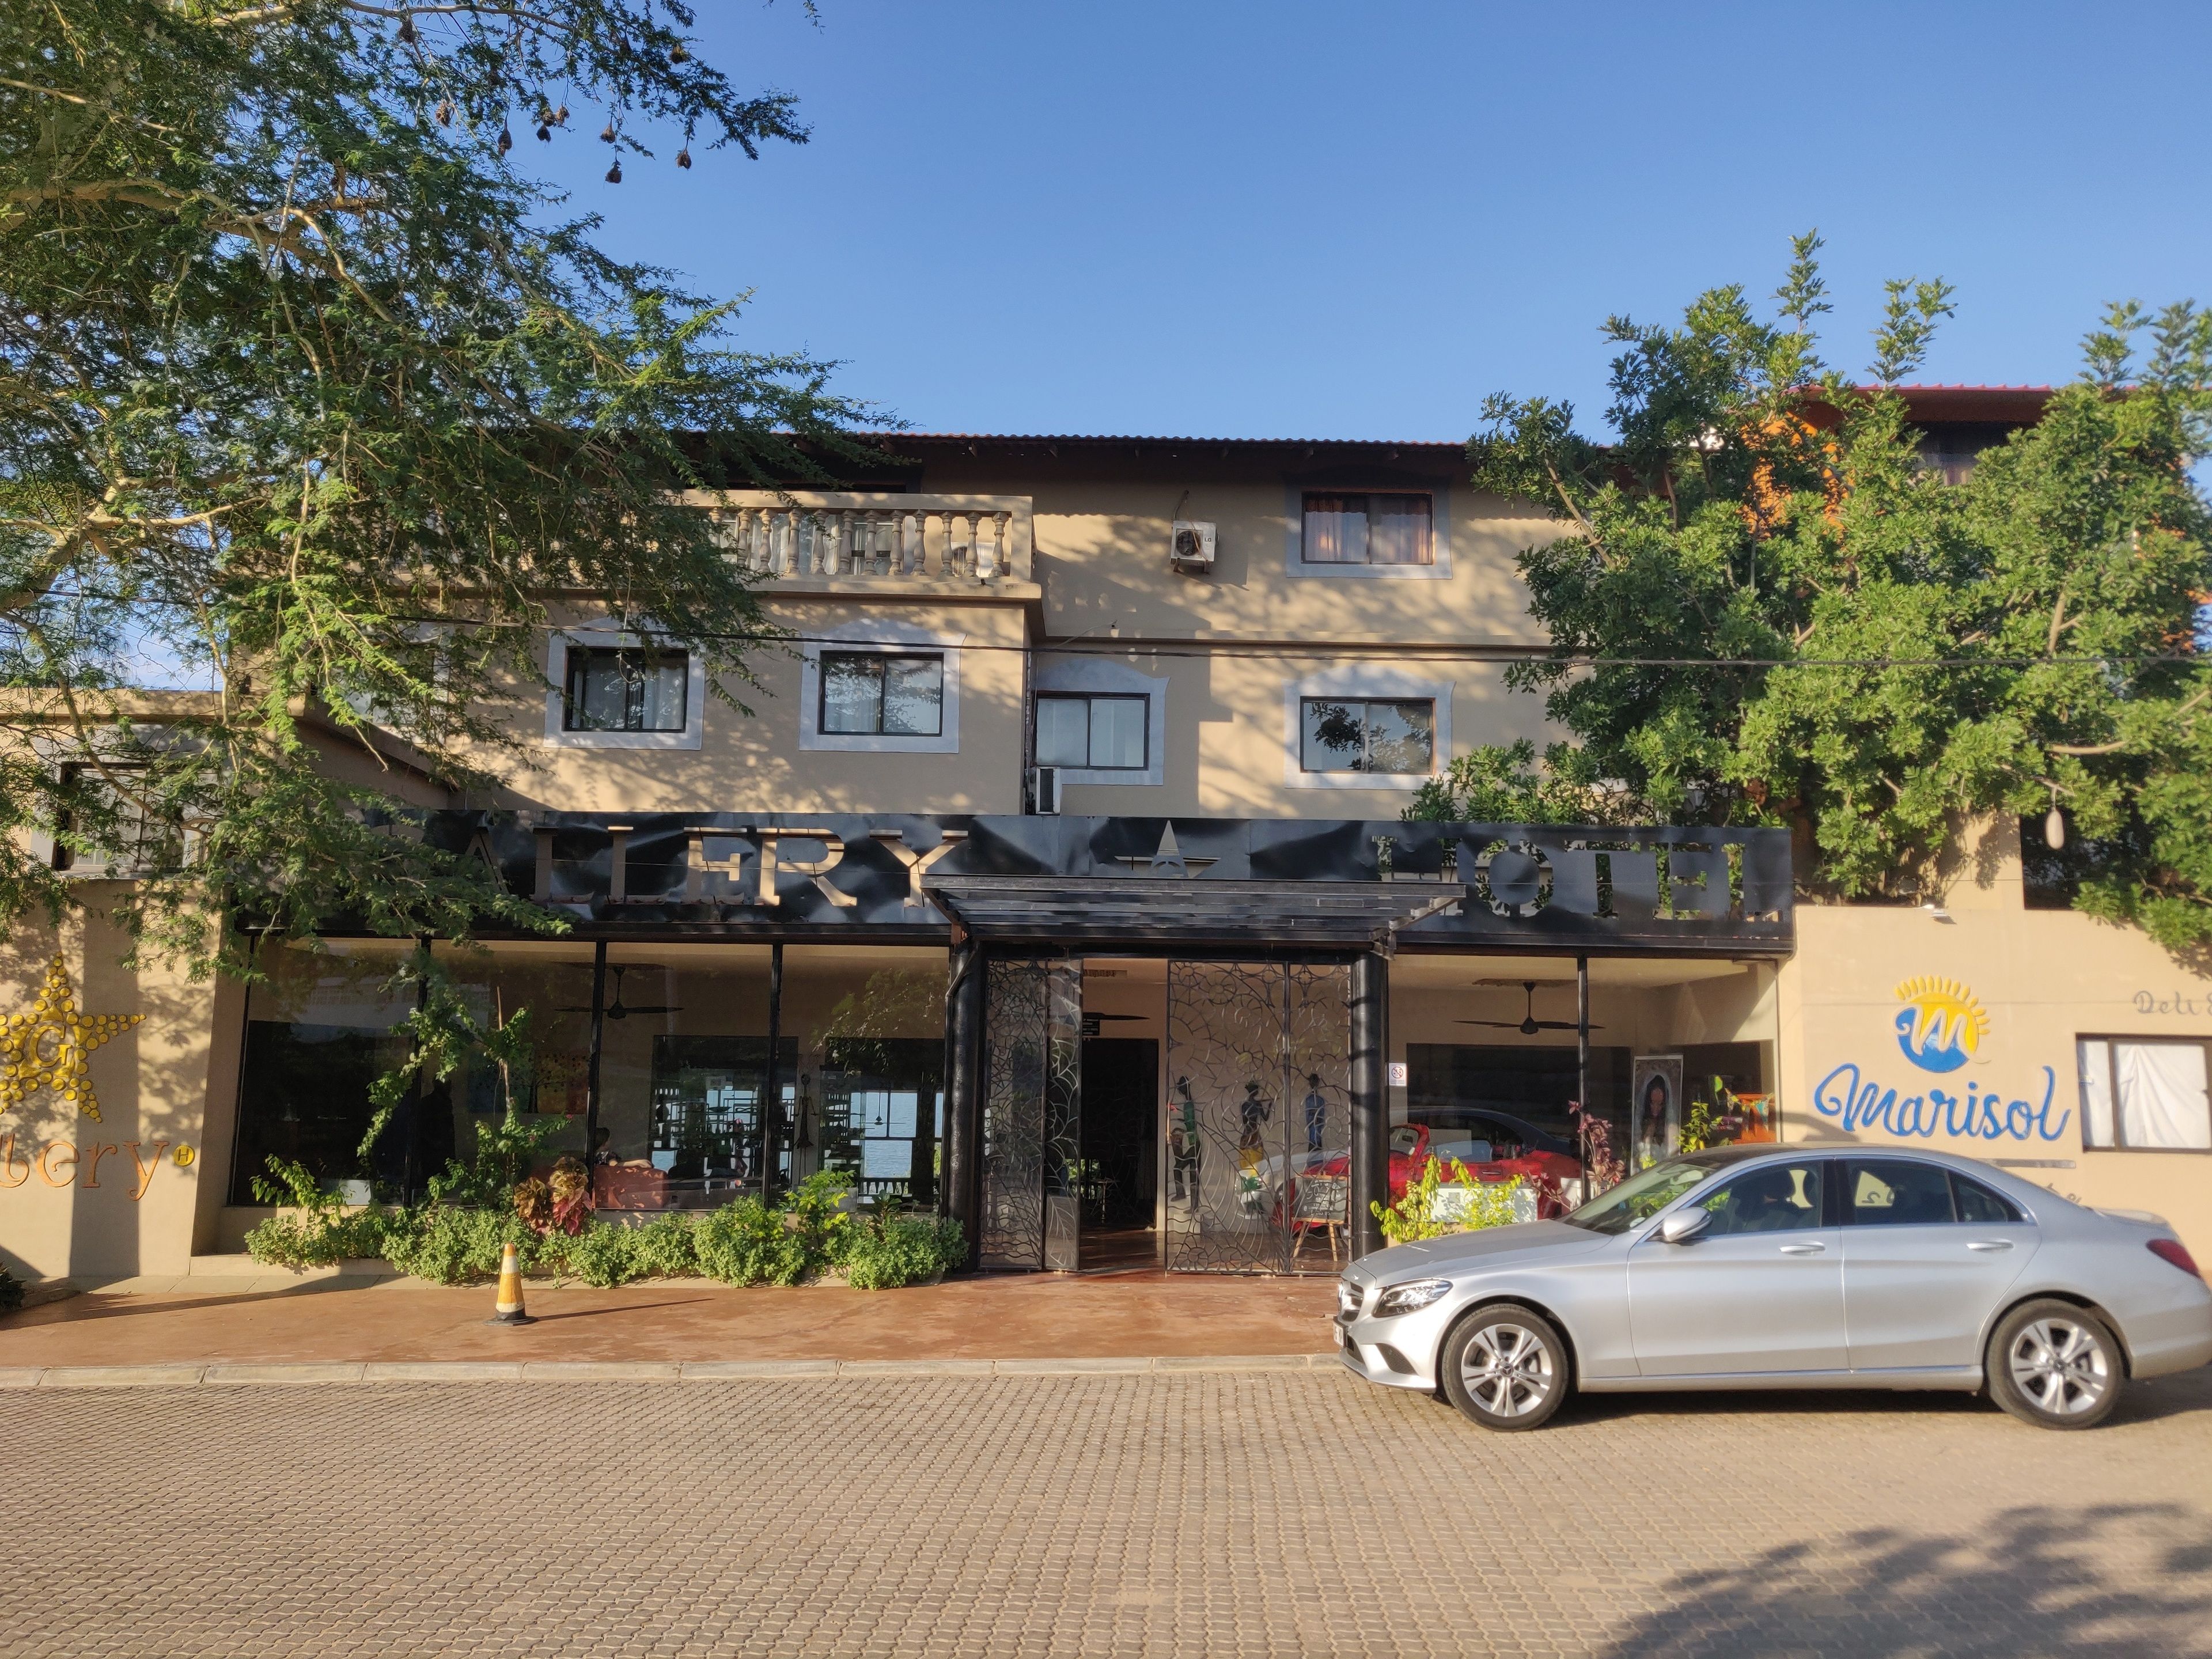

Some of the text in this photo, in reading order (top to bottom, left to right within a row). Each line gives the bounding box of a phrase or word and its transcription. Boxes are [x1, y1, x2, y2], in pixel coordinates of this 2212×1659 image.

[369, 821, 1780, 922] ALLERY HOTEL
[2133, 990, 2200, 1016] Deli
[29, 1024, 73, 1067] G
[1814, 1063, 2071, 1142] Marisol
[0, 1132, 170, 1201] lery
